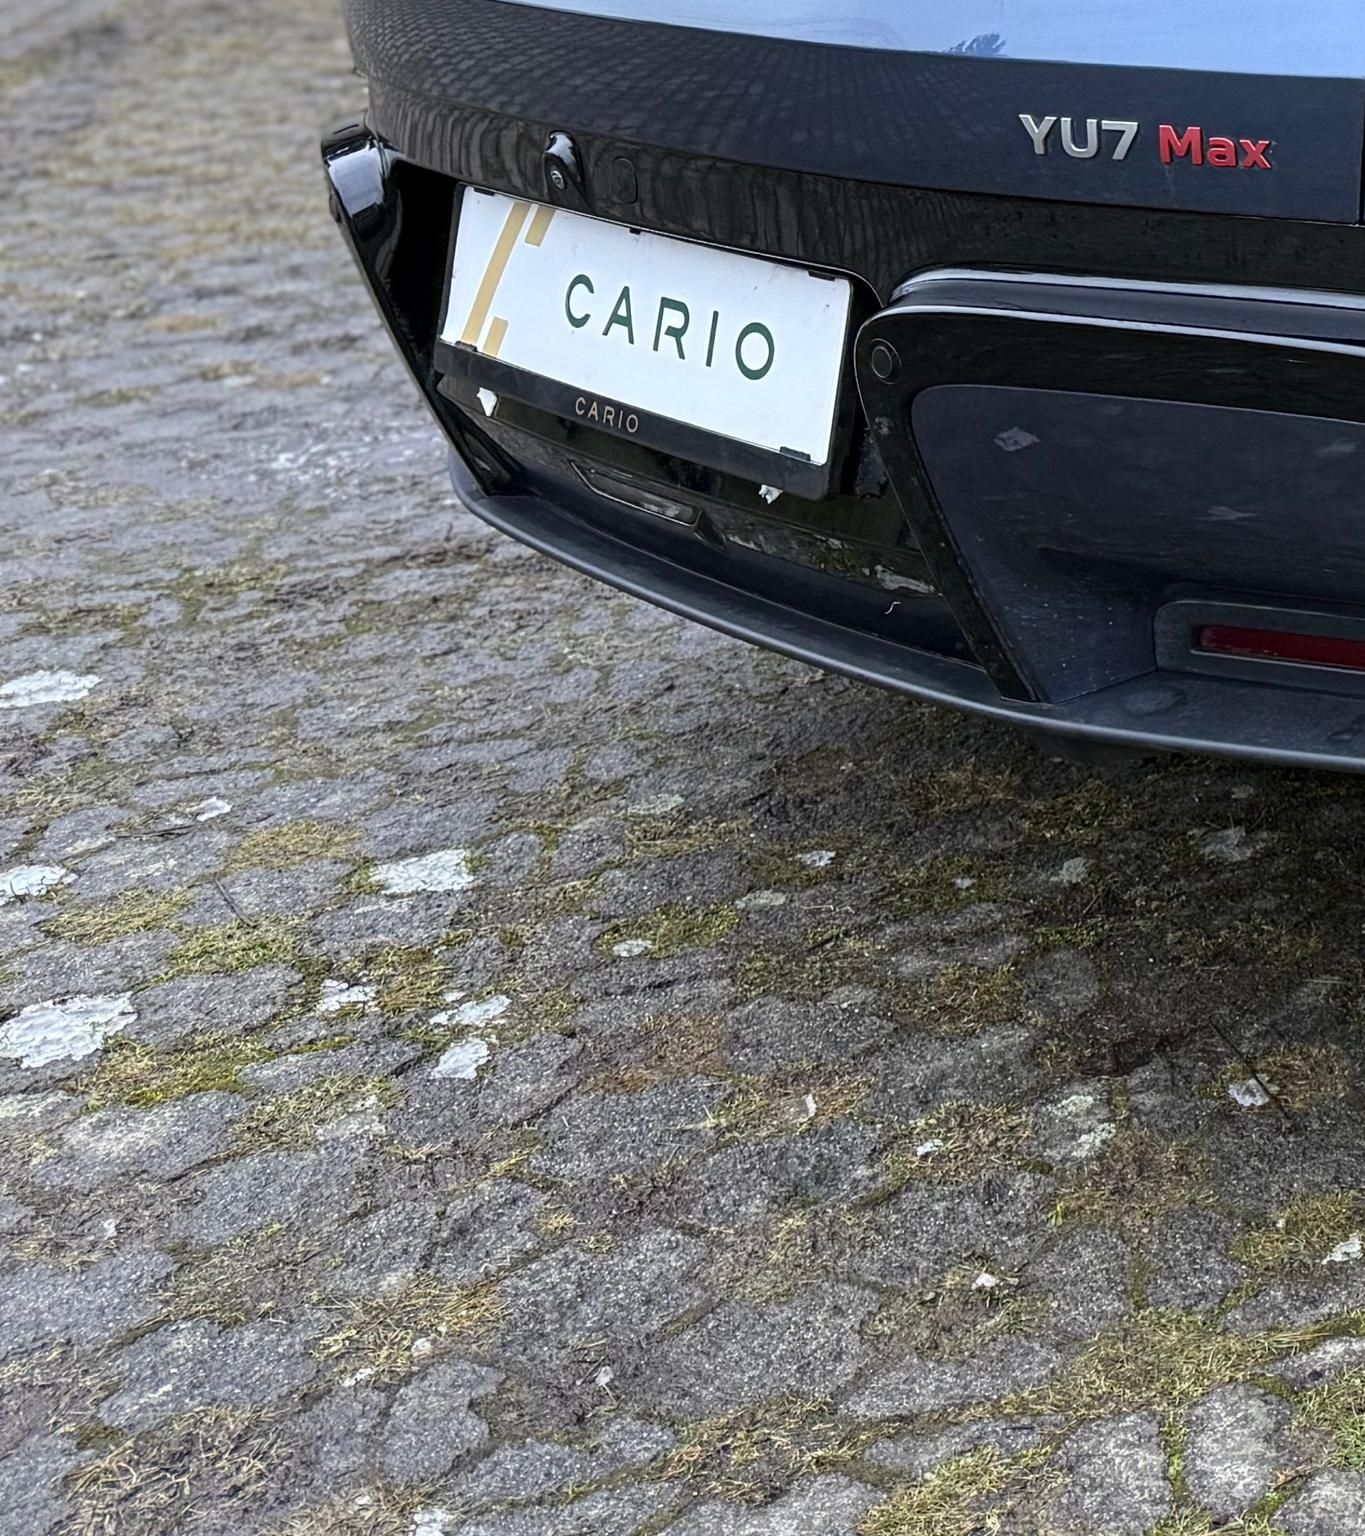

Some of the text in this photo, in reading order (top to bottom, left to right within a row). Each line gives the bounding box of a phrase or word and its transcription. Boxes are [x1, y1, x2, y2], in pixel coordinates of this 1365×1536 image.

[1018, 113, 1273, 170] YU7 Max
[564, 273, 775, 381] CARIO
[574, 396, 640, 434] CARIO
